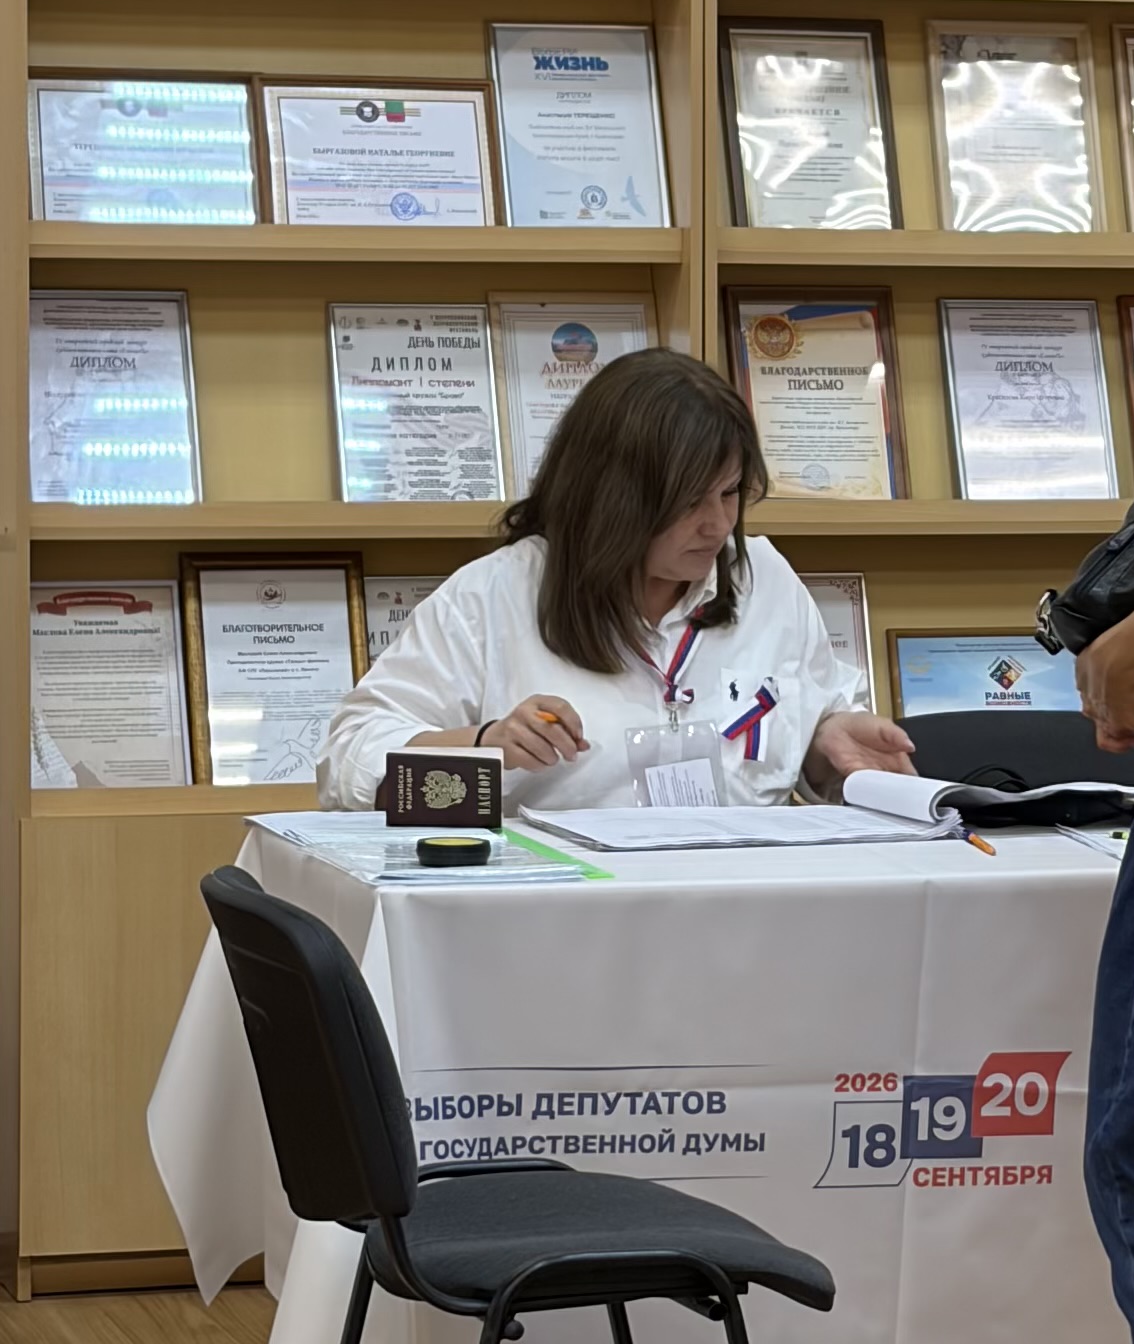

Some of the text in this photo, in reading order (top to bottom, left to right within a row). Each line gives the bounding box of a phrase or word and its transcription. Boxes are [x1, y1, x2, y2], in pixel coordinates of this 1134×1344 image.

[533, 56, 609, 71] ЖИЗНЬ
[407, 336, 481, 350] ДЕНЬ ПОБЕДЫ
[70, 356, 137, 368] ДИПЛОМ
[371, 357, 453, 372] ДИПЛОМ
[541, 361, 607, 375] ДИПЛО
[995, 361, 1054, 372] ДИПЛОМ
[760, 366, 868, 376] БЛАГОДАРСТВЕННОЕ
[788, 379, 844, 390] ПИСЬМО
[388, 609, 411, 623] ДЕН
[222, 624, 325, 634] БЛАГОТВОРИТЕЛЬНОЕ
[253, 635, 296, 644] ПИСЬМО
[985, 691, 1031, 701] РАВНЫЕ
[397, 765, 405, 813] РОССИЙСКАЯ
[477, 767, 491, 815] ПАСПОРТ
[834, 1073, 898, 1093] 2026
[980, 1071, 1050, 1117] 20
[531, 1091, 727, 1120] ДЕПУТАТОВ
[910, 1096, 967, 1141] 19
[419, 1128, 766, 1160] ГОСУДАРСТВЕННОЙ ДУМЫ
[841, 1123, 896, 1168] 18
[912, 1164, 1053, 1188] СЕНТЯБРЯ
